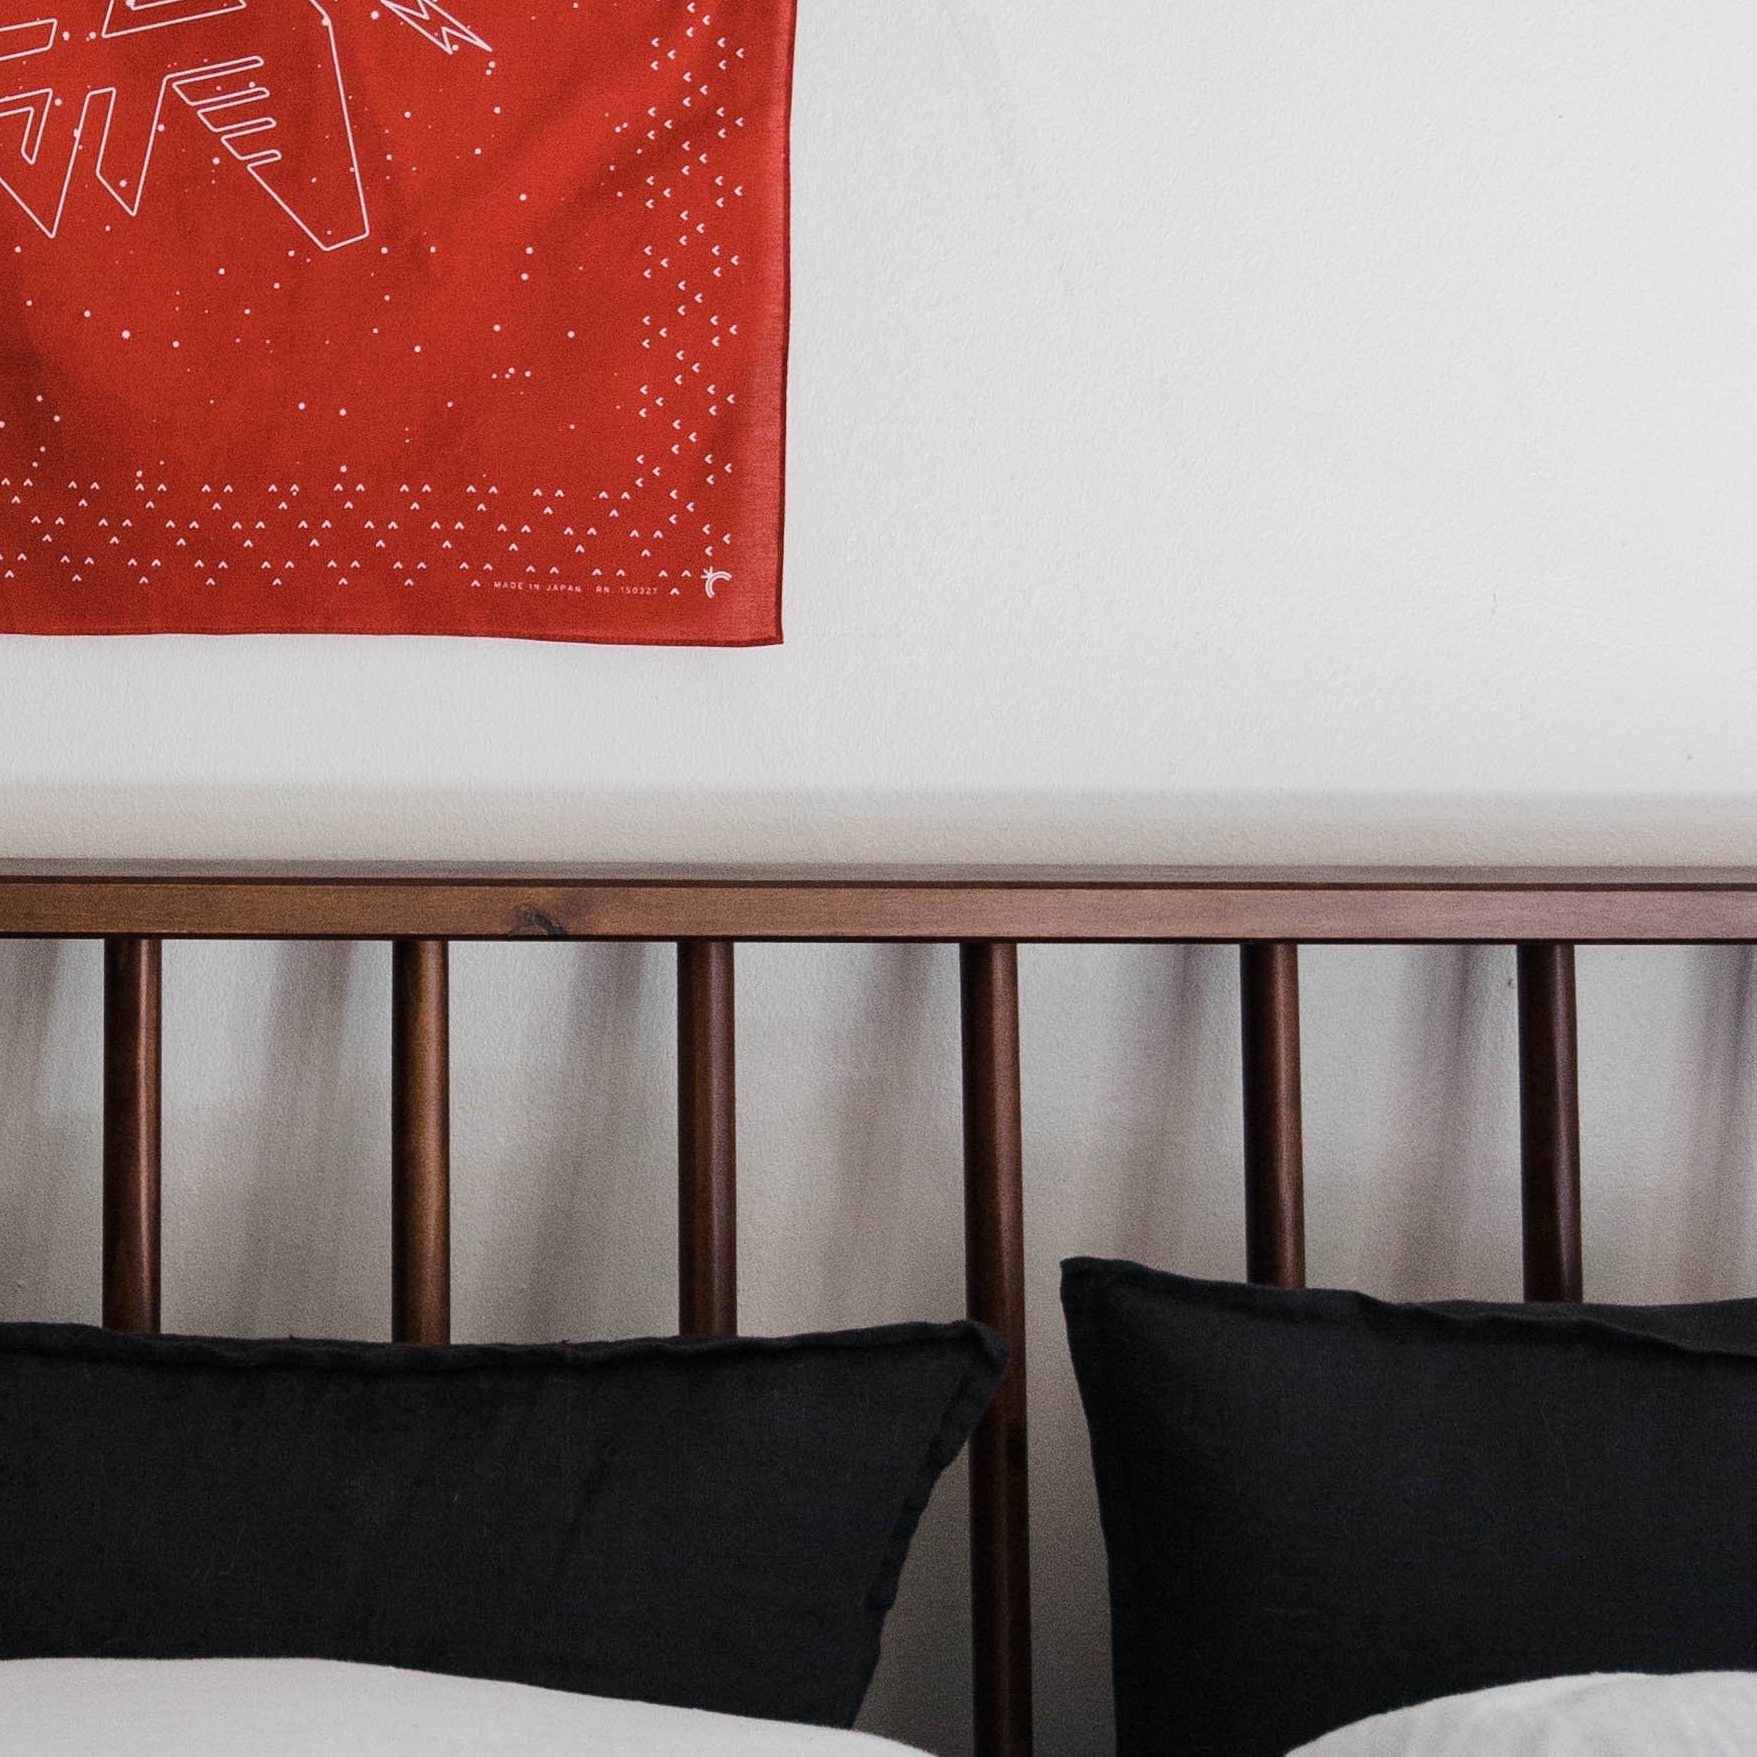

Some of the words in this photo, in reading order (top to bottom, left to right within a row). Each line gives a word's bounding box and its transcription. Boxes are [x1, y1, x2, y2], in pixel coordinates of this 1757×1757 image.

[493, 581, 523, 590] MADE
[529, 583, 540, 591] IN
[547, 583, 582, 593] JAPAN
